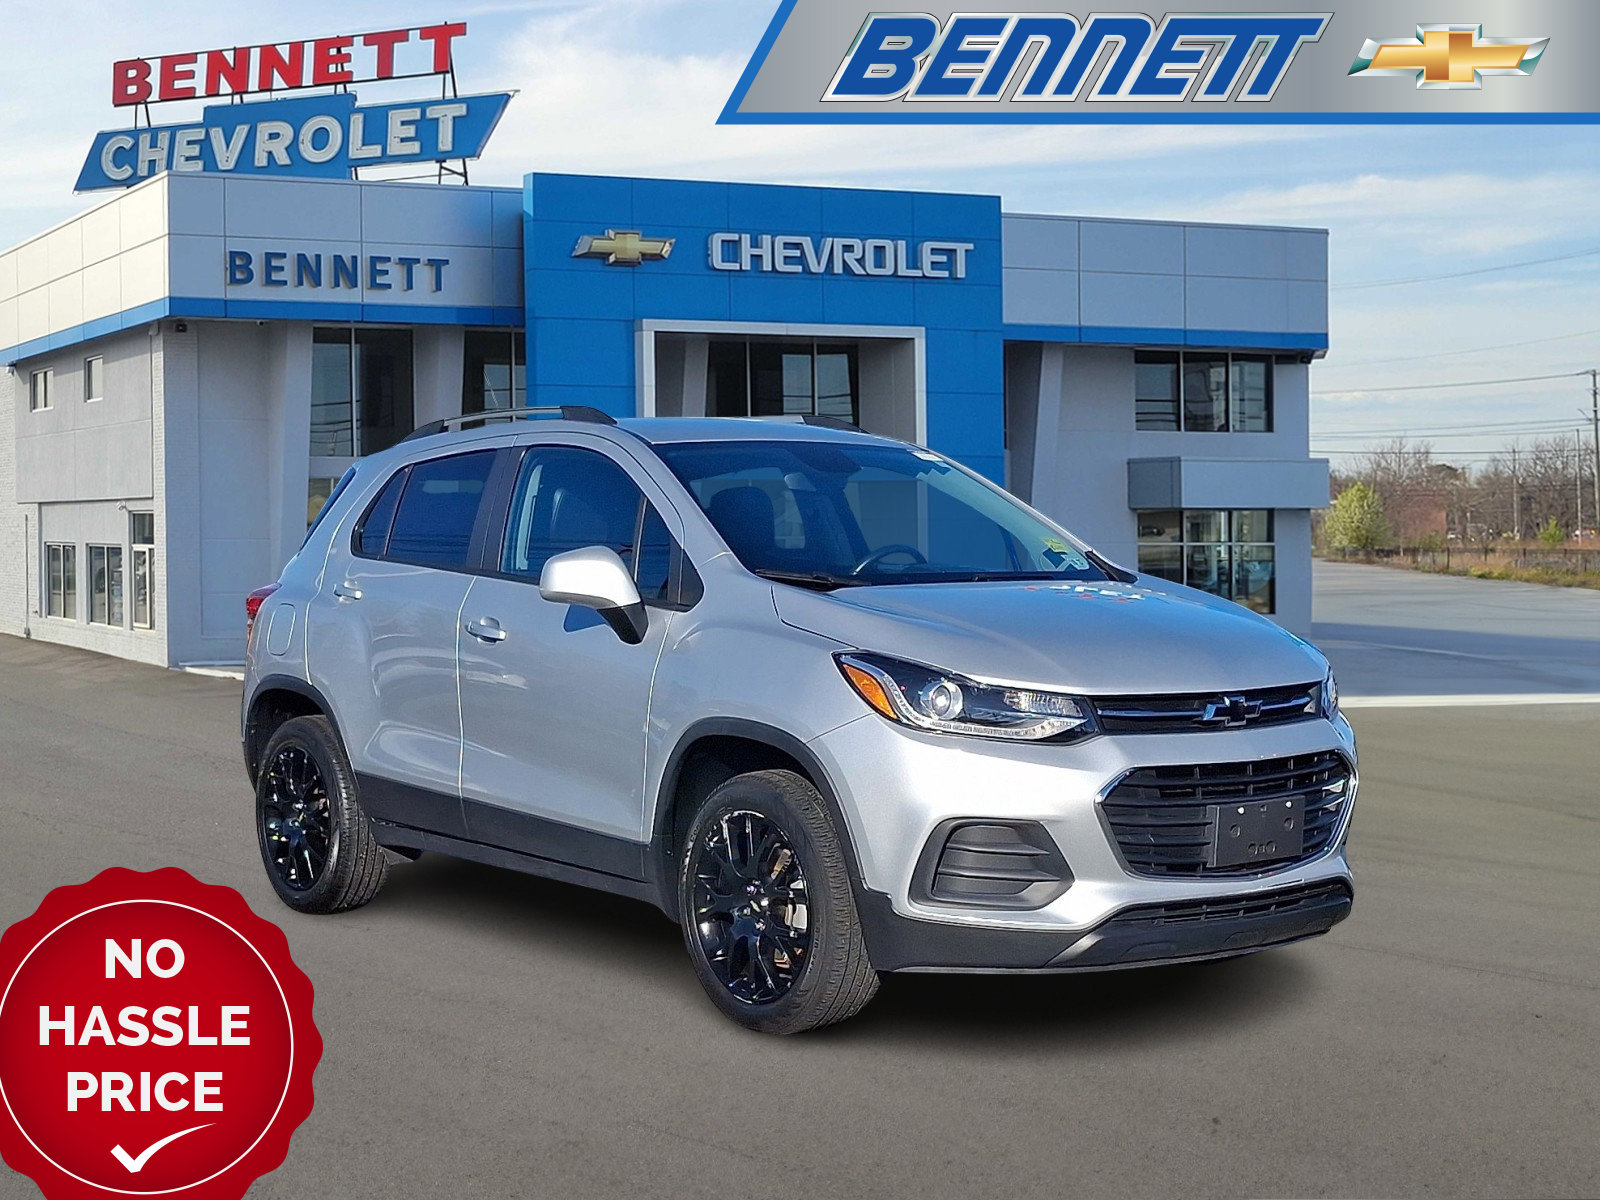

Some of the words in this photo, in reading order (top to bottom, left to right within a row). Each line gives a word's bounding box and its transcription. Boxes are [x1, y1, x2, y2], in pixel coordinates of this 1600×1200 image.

[112, 23, 467, 106] BENNETT
[100, 103, 467, 181] CHEVROLET
[228, 250, 450, 292] BENNETT
[708, 232, 974, 278] CHEVROLET
